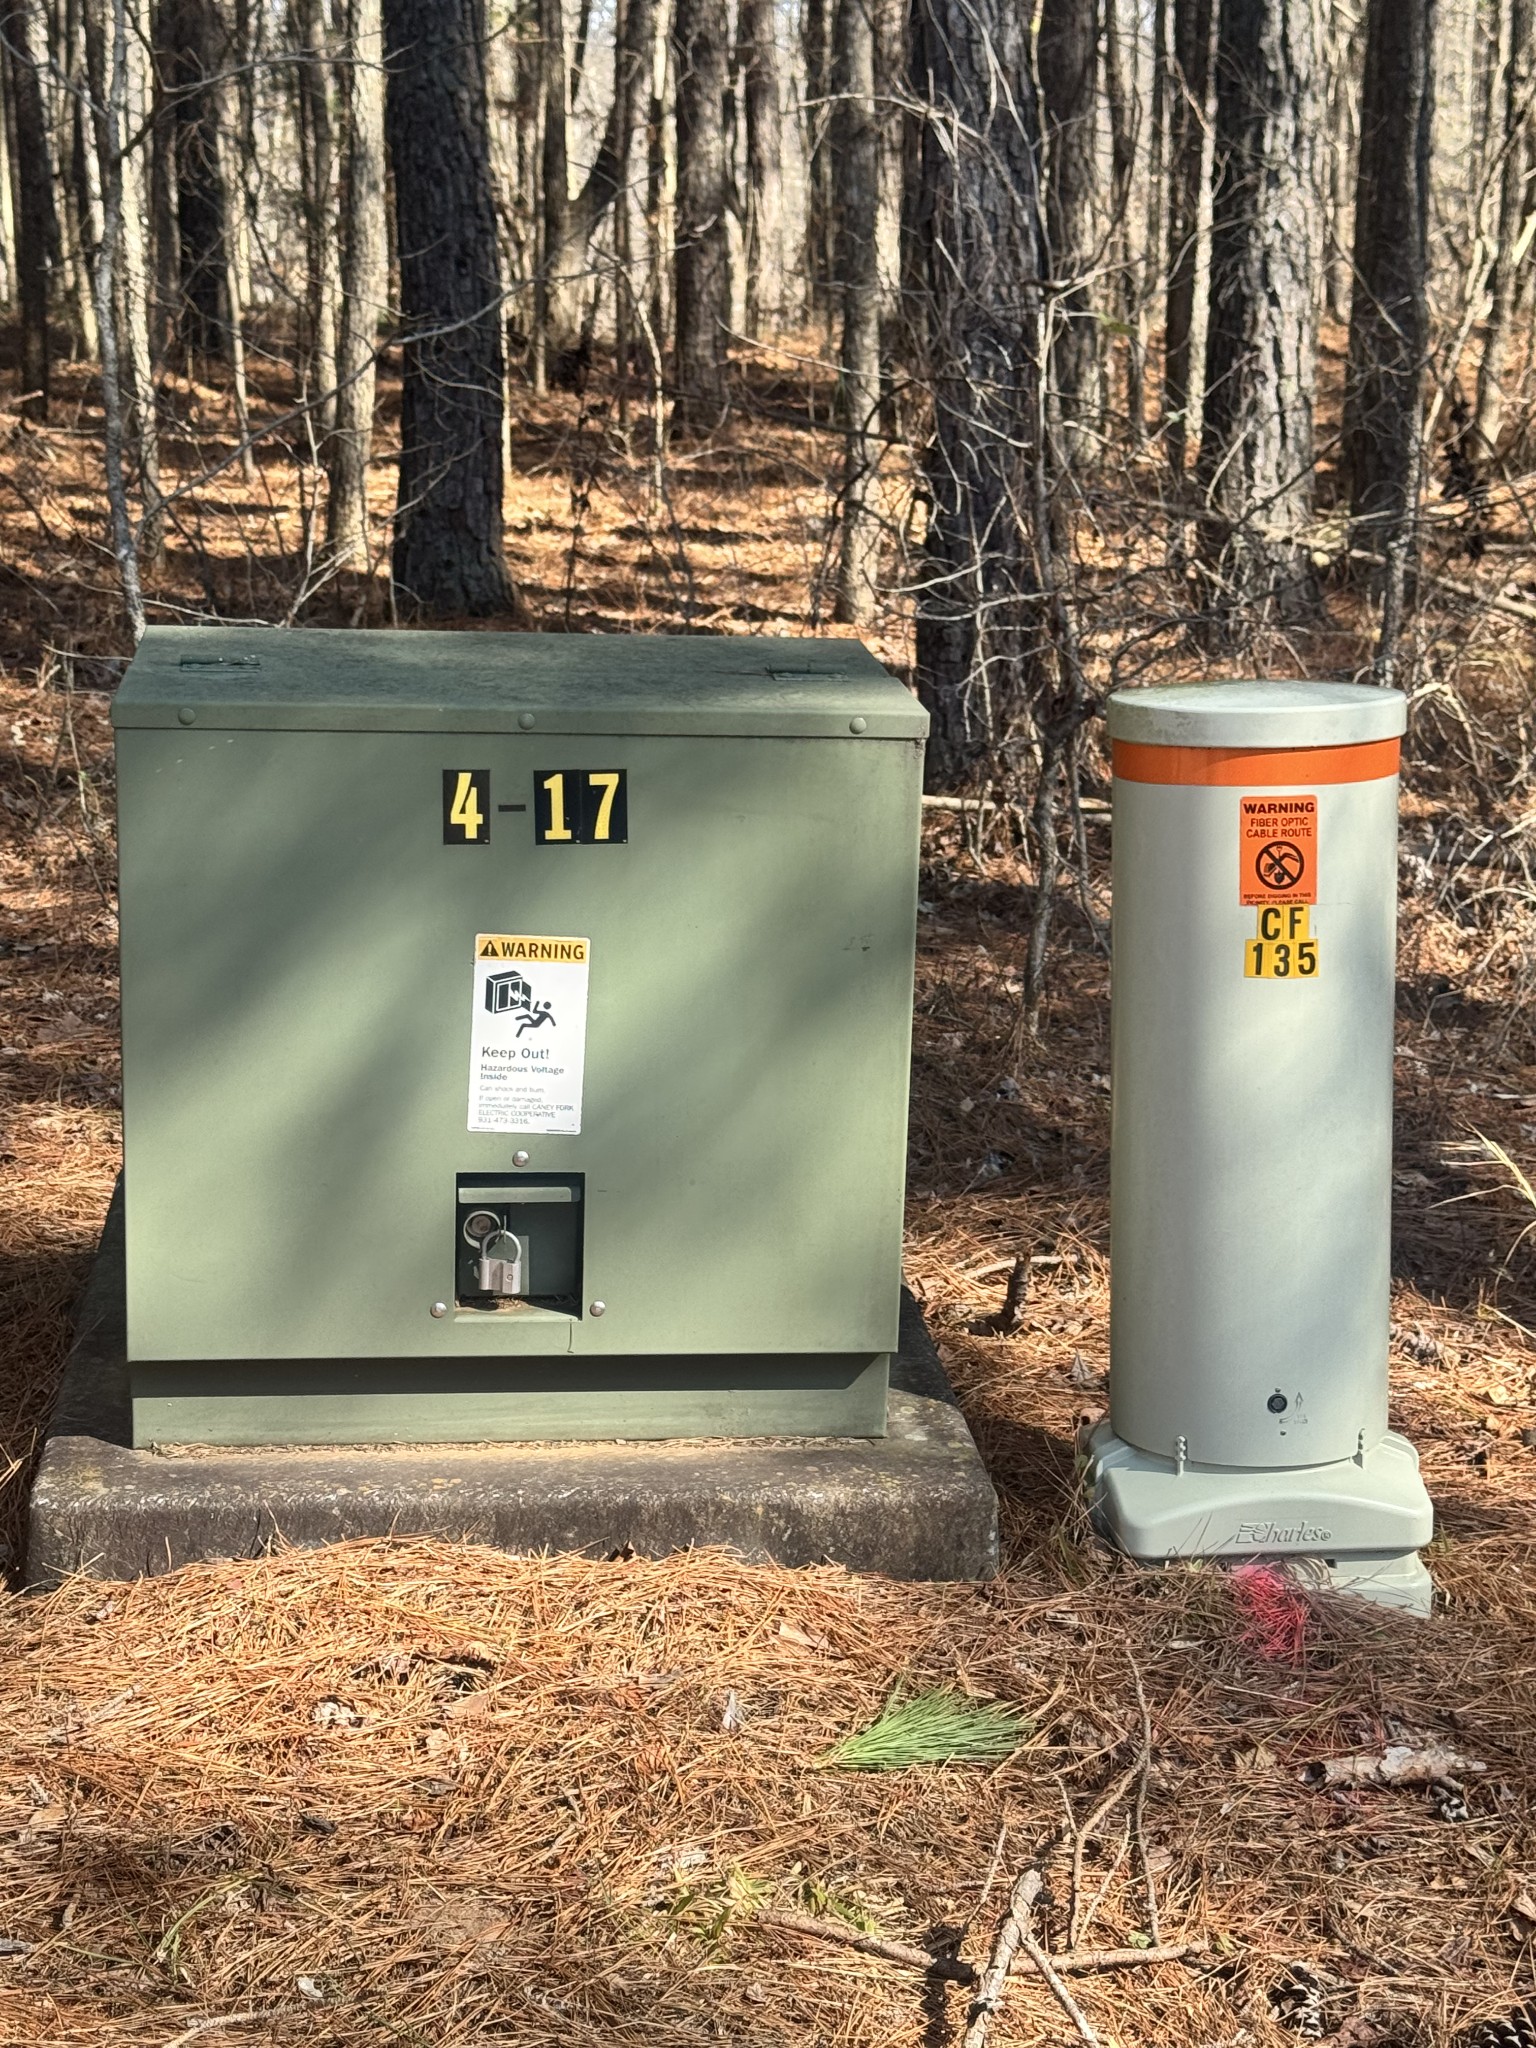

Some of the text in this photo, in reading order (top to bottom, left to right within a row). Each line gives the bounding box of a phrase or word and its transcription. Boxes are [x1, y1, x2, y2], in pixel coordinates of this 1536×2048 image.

[451, 772, 619, 839] 4-17
[1243, 802, 1315, 814] WARNING
[1250, 816, 1308, 827] FIBER OPTIC
[1246, 827, 1312, 838] CABLE ROUTE
[1261, 906, 1304, 941] CF
[501, 941, 585, 960] WARNING
[1252, 942, 1316, 977] 135
[481, 1046, 550, 1060] Keep Out!
[480, 1063, 565, 1075] Hazardous Voltage
